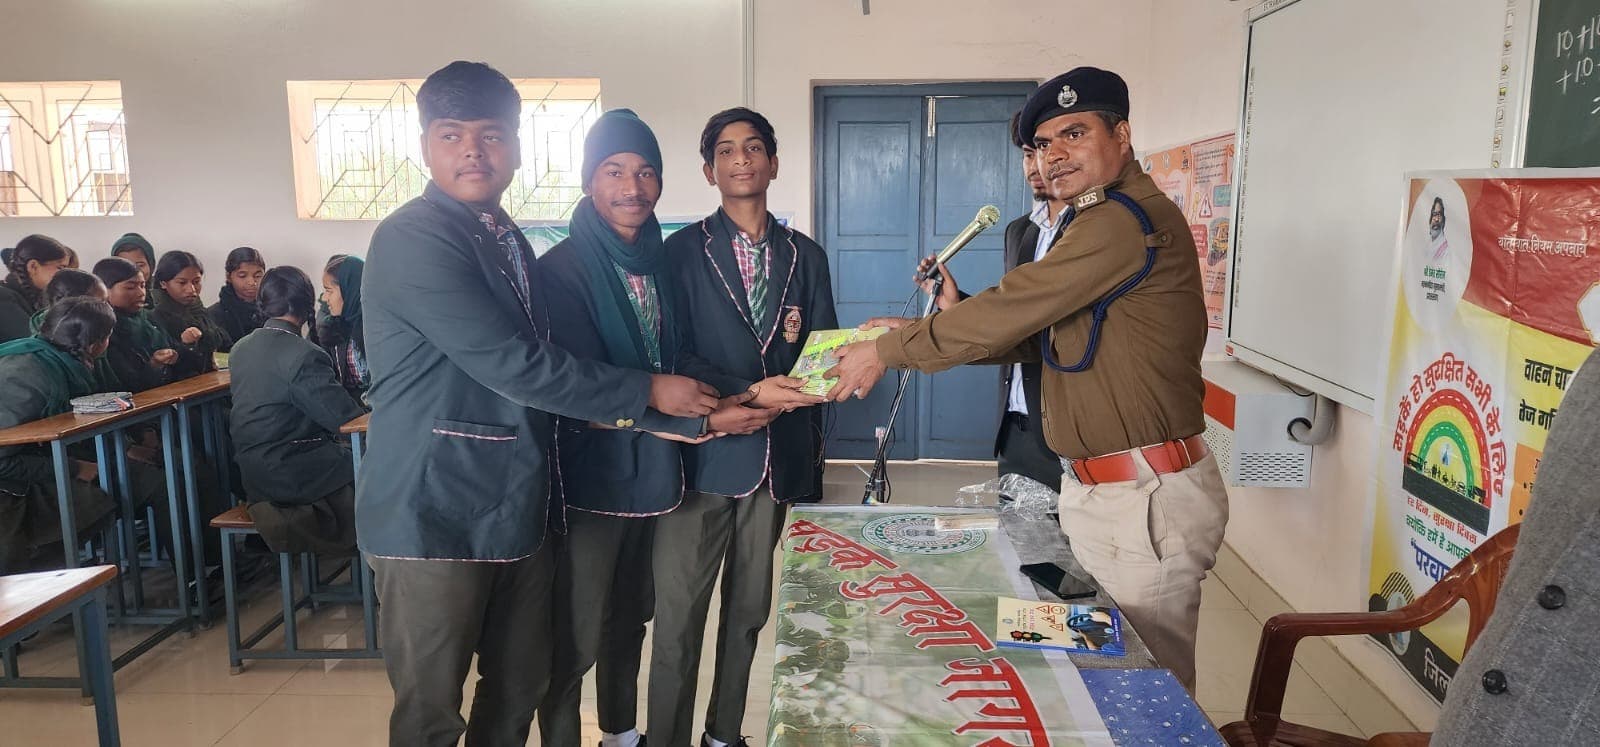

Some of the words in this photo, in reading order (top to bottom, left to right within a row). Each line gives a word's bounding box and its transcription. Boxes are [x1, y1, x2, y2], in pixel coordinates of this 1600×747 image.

[1078, 191, 1098, 207] JPS
[1524, 358, 1554, 386] वाहन
[1555, 366, 1575, 391] चा
[1410, 375, 1423, 404] हो
[1423, 352, 1465, 392] सुरक्षित
[1465, 365, 1492, 412] सभी
[1486, 406, 1502, 437] के
[1518, 399, 1537, 425] तेज
[838, 572, 997, 653] सुरक्षा
[1424, 647, 1452, 693] जिल
